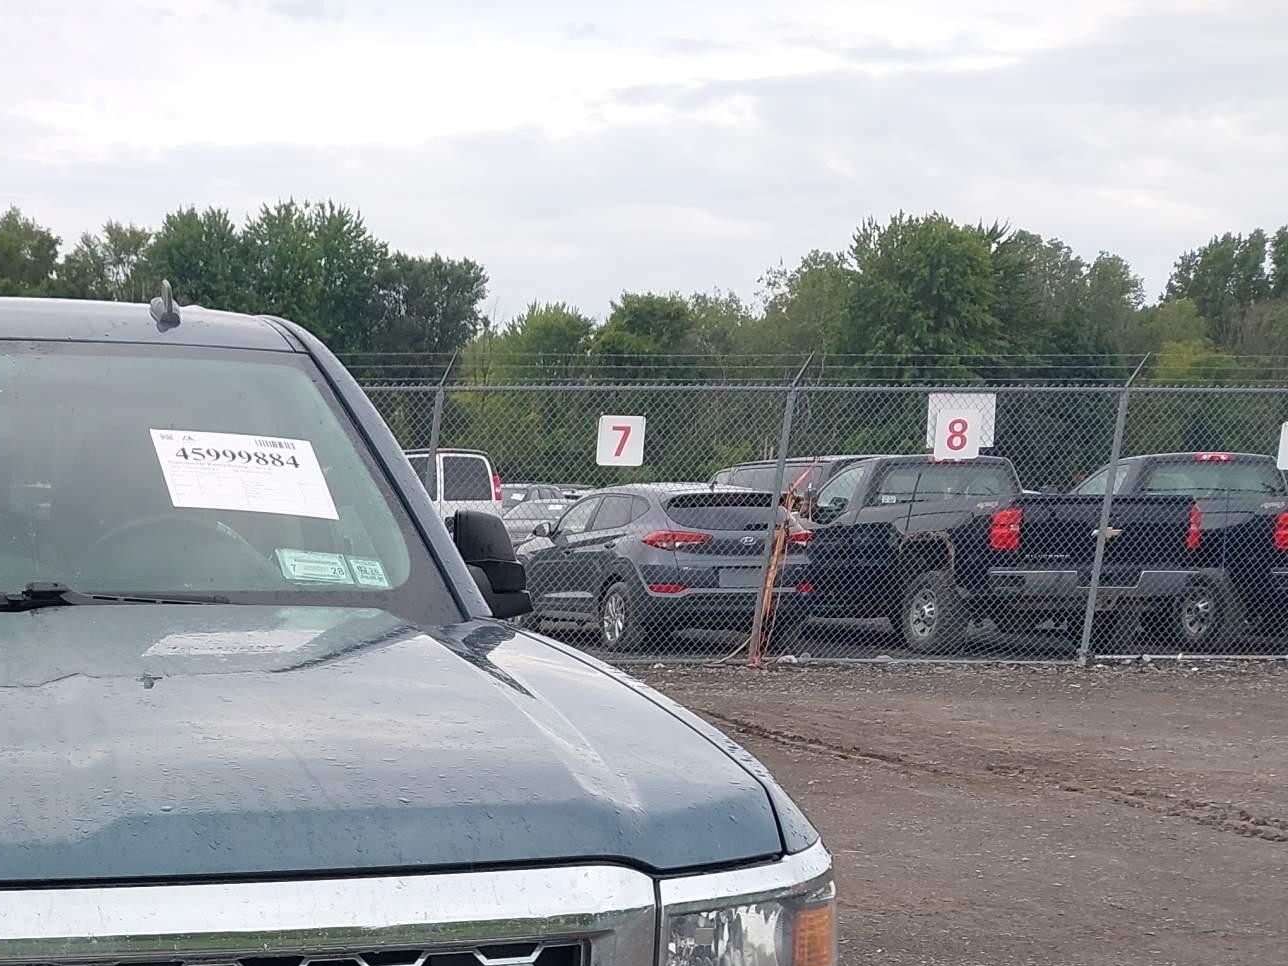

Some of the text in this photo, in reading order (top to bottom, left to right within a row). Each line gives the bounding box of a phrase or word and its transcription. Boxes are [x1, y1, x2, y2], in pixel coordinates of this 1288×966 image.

[612, 425, 632, 457] 7
[946, 418, 968, 451] 8
[175, 446, 301, 469] 45999884
